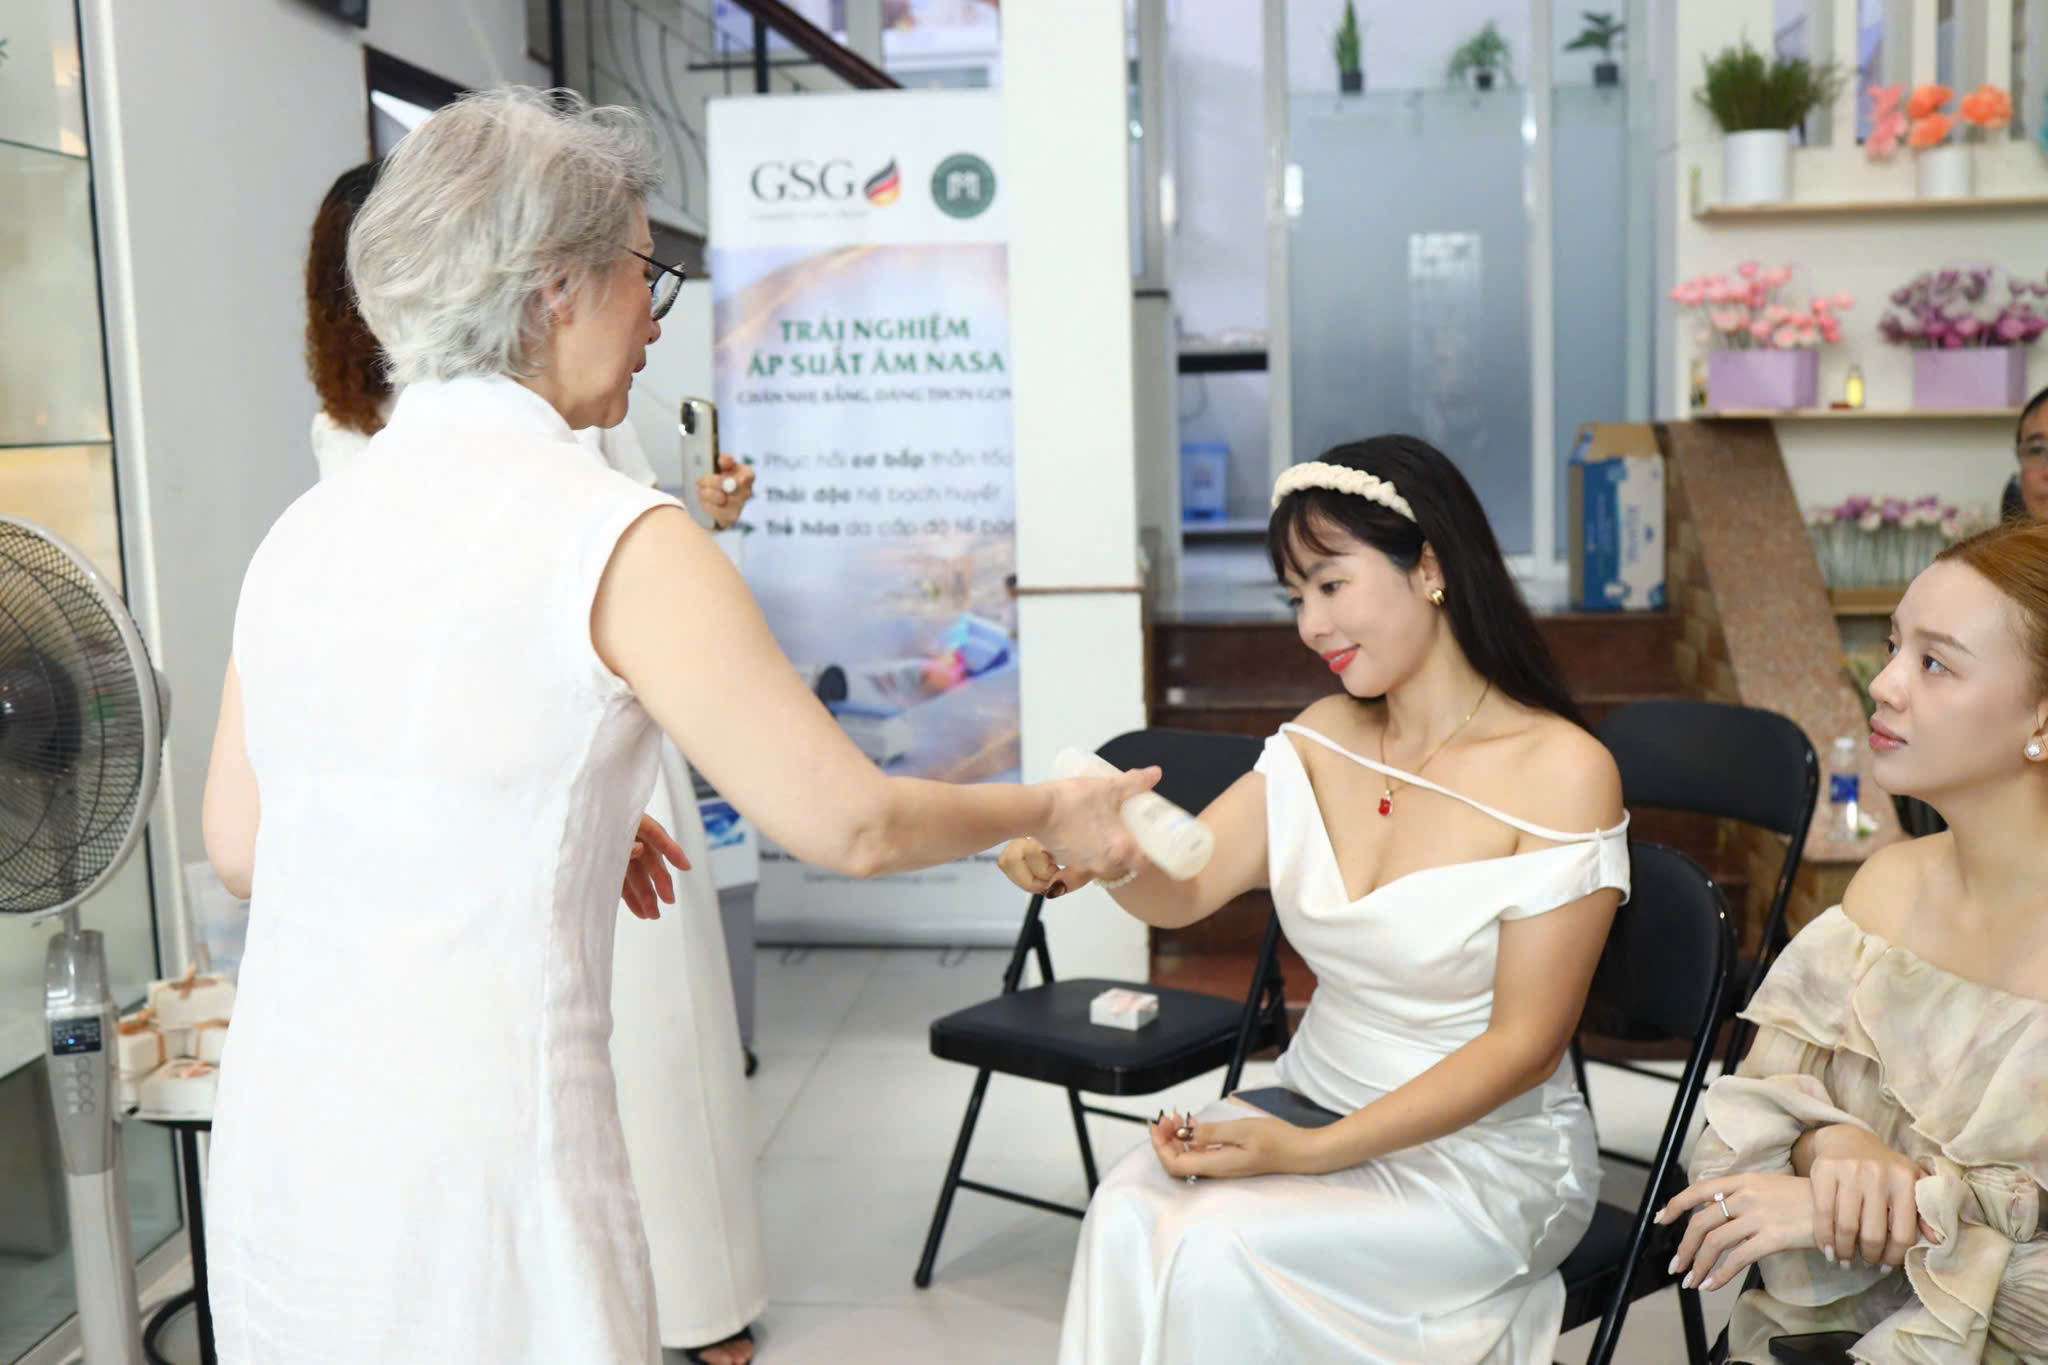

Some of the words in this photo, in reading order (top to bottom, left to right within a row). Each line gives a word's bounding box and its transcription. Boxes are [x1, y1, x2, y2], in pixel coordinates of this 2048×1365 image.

[751, 159, 856, 204] GSG
[852, 311, 970, 343] NGHIỆM
[746, 347, 784, 377] ÁP
[790, 344, 864, 376] SUẤT
[925, 350, 1006, 374] NASA
